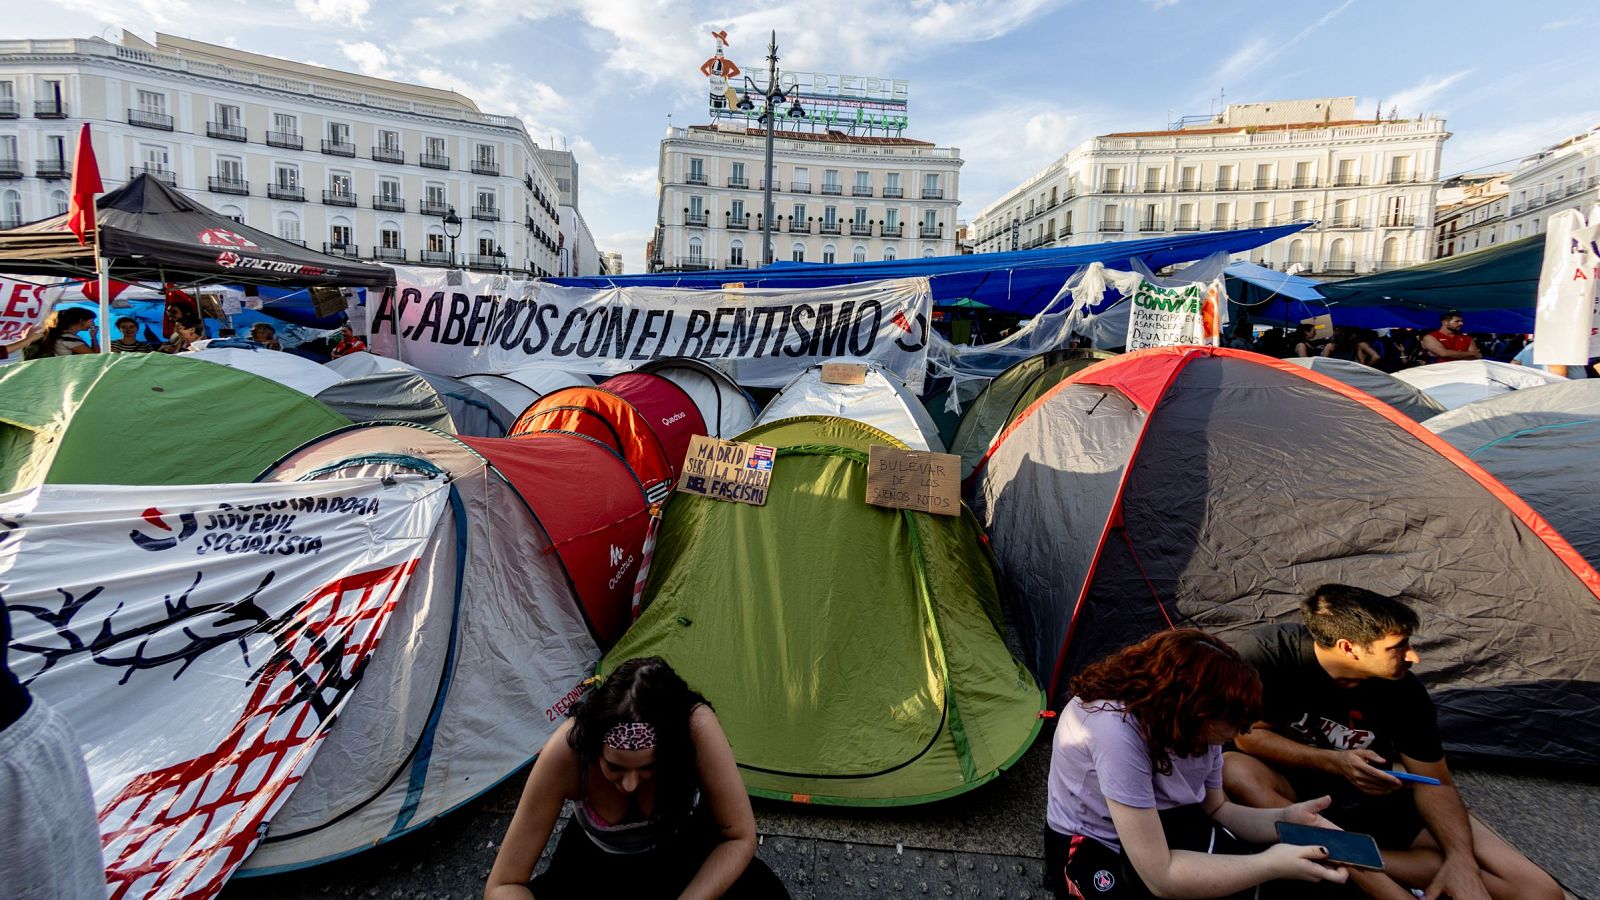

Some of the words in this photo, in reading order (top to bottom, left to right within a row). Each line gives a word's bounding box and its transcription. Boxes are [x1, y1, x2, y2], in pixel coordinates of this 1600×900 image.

[745, 66, 797, 90] TO
[813, 72, 909, 99] PEPE
[1139, 280, 1178, 298] PARA
[371, 287, 558, 355] ACABEMOS
[551, 306, 638, 360] CON
[629, 308, 674, 361] EL
[677, 299, 882, 359] RENTISMO
[1132, 328, 1160, 341] DEJA
[1134, 320, 1184, 330] ASAMBLEAS
[661, 411, 686, 426] Quechua
[697, 443, 744, 465] MADRID
[686, 457, 708, 476] SERÁ
[713, 465, 729, 480] LA
[734, 467, 769, 488] TUMBA
[879, 459, 946, 477] BULEVAR
[686, 475, 707, 495] DEL
[710, 480, 764, 505] FASCISMO
[892, 475, 906, 486] DE
[920, 479, 940, 488] LOS
[872, 487, 910, 502] SUEÑOS
[917, 494, 950, 508] ROTOS
[204, 513, 297, 534] JUVENIL
[196, 532, 324, 556] SOCIALISTA
[608, 554, 634, 590] Quechua
